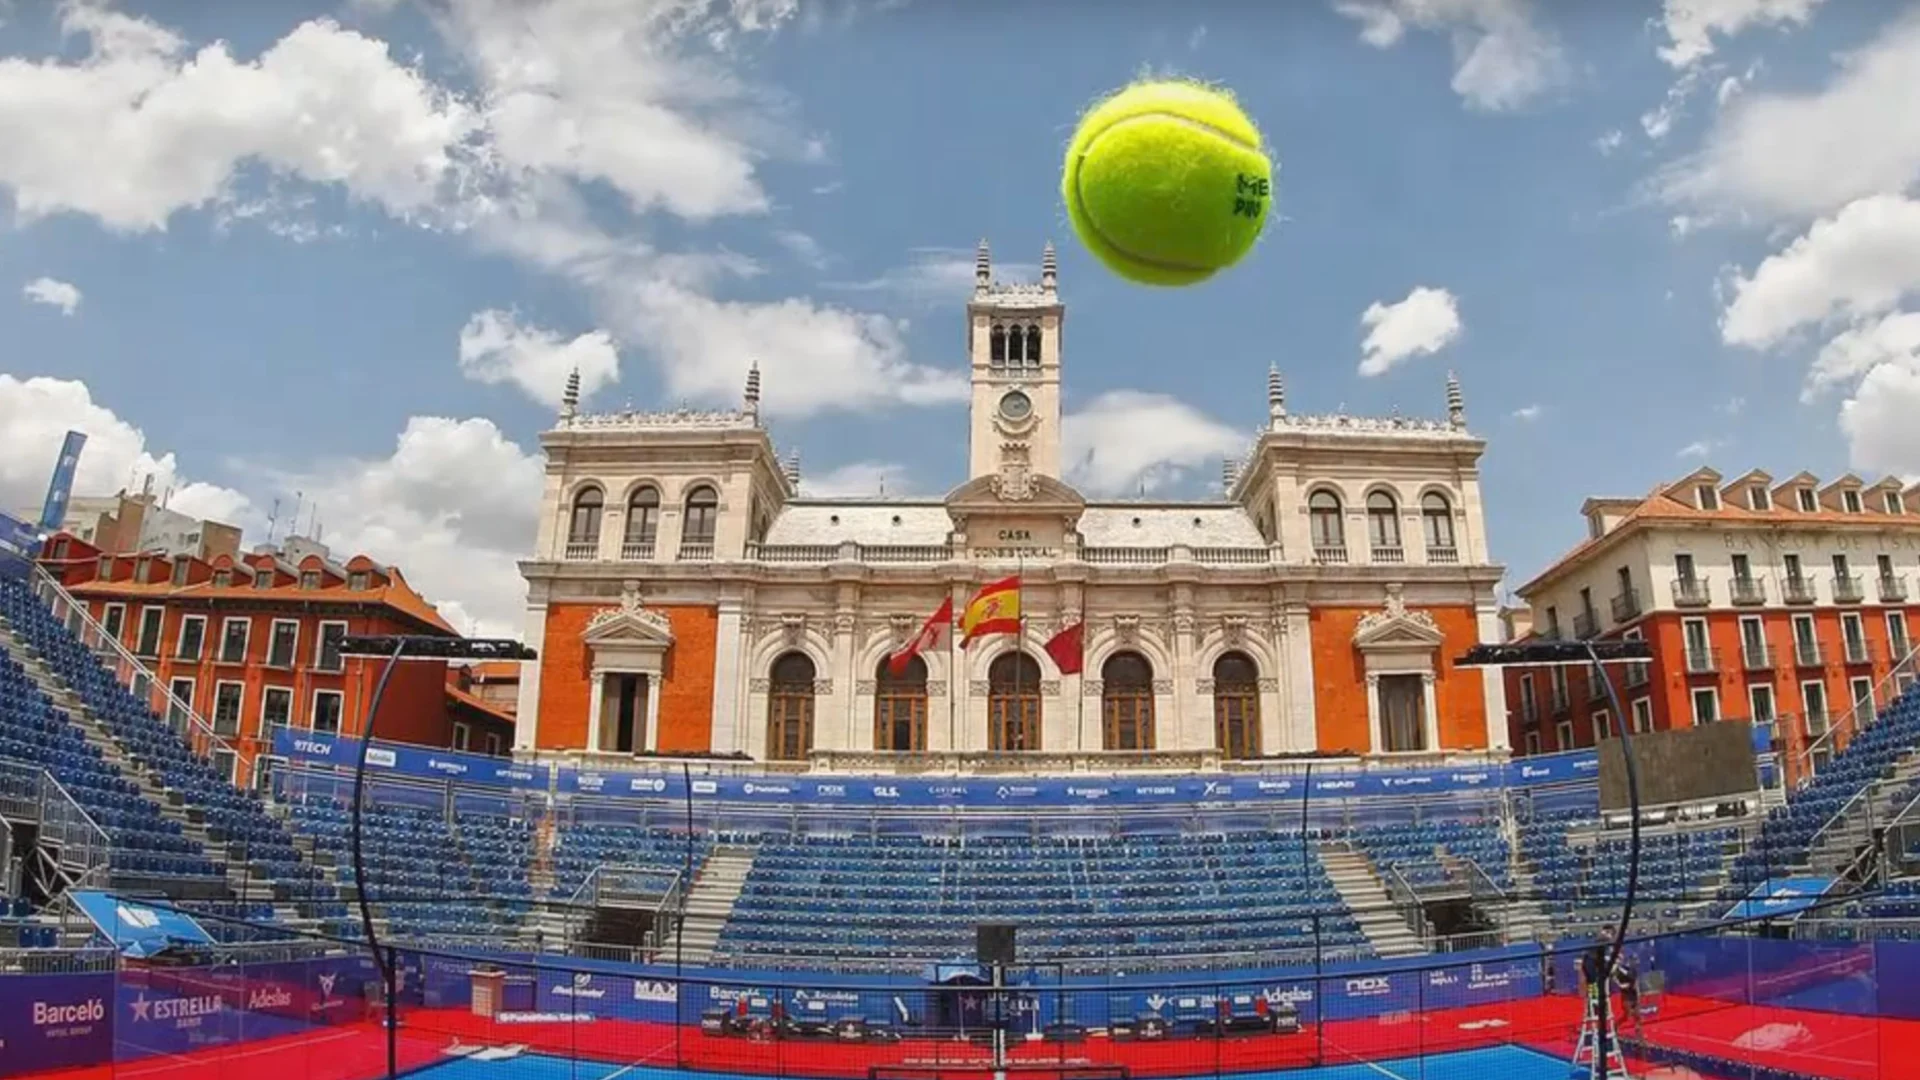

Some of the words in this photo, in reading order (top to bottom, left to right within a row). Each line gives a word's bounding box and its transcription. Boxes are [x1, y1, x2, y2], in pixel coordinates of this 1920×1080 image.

[998, 529, 1031, 541] CASA
[33, 999, 104, 1025] Barceló
[154, 994, 222, 1019] ESTRELLA
